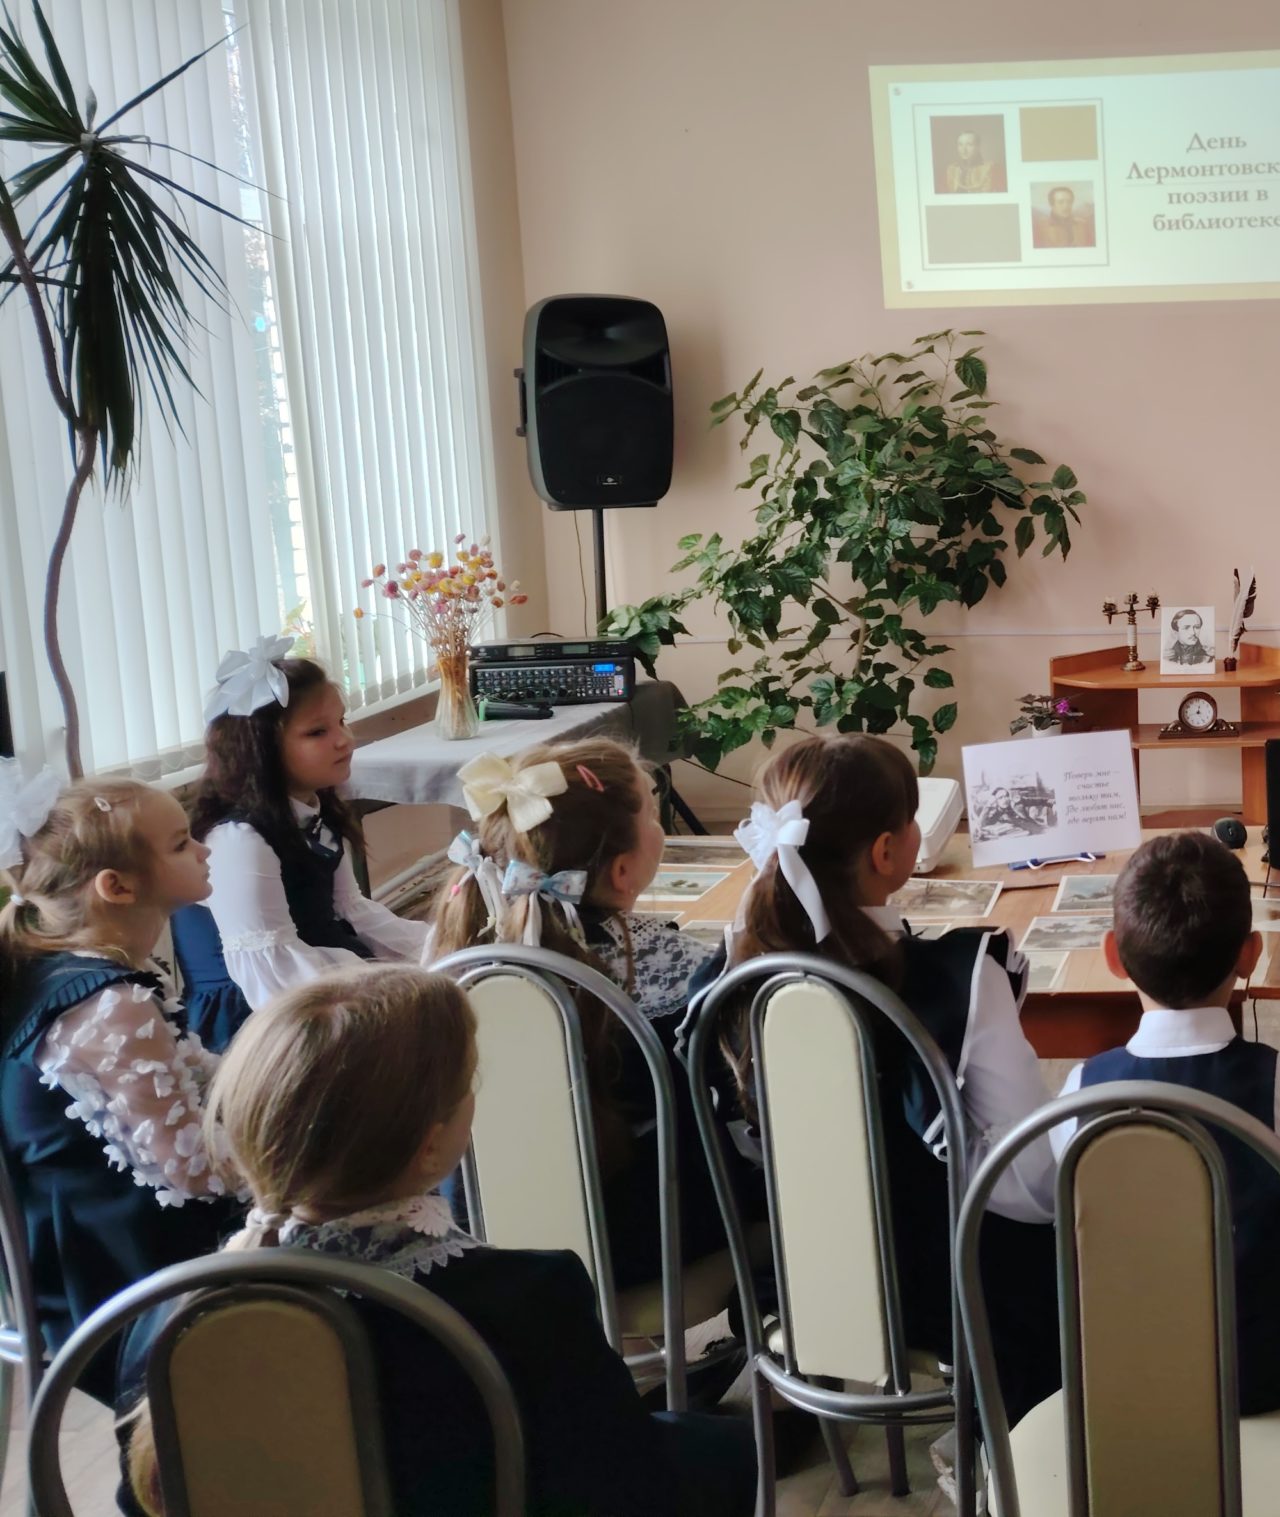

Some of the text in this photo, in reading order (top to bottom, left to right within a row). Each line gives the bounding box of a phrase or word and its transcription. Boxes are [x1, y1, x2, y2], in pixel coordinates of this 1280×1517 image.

[1186, 132, 1246, 153] День
[1168, 189, 1269, 204] поэзии в
